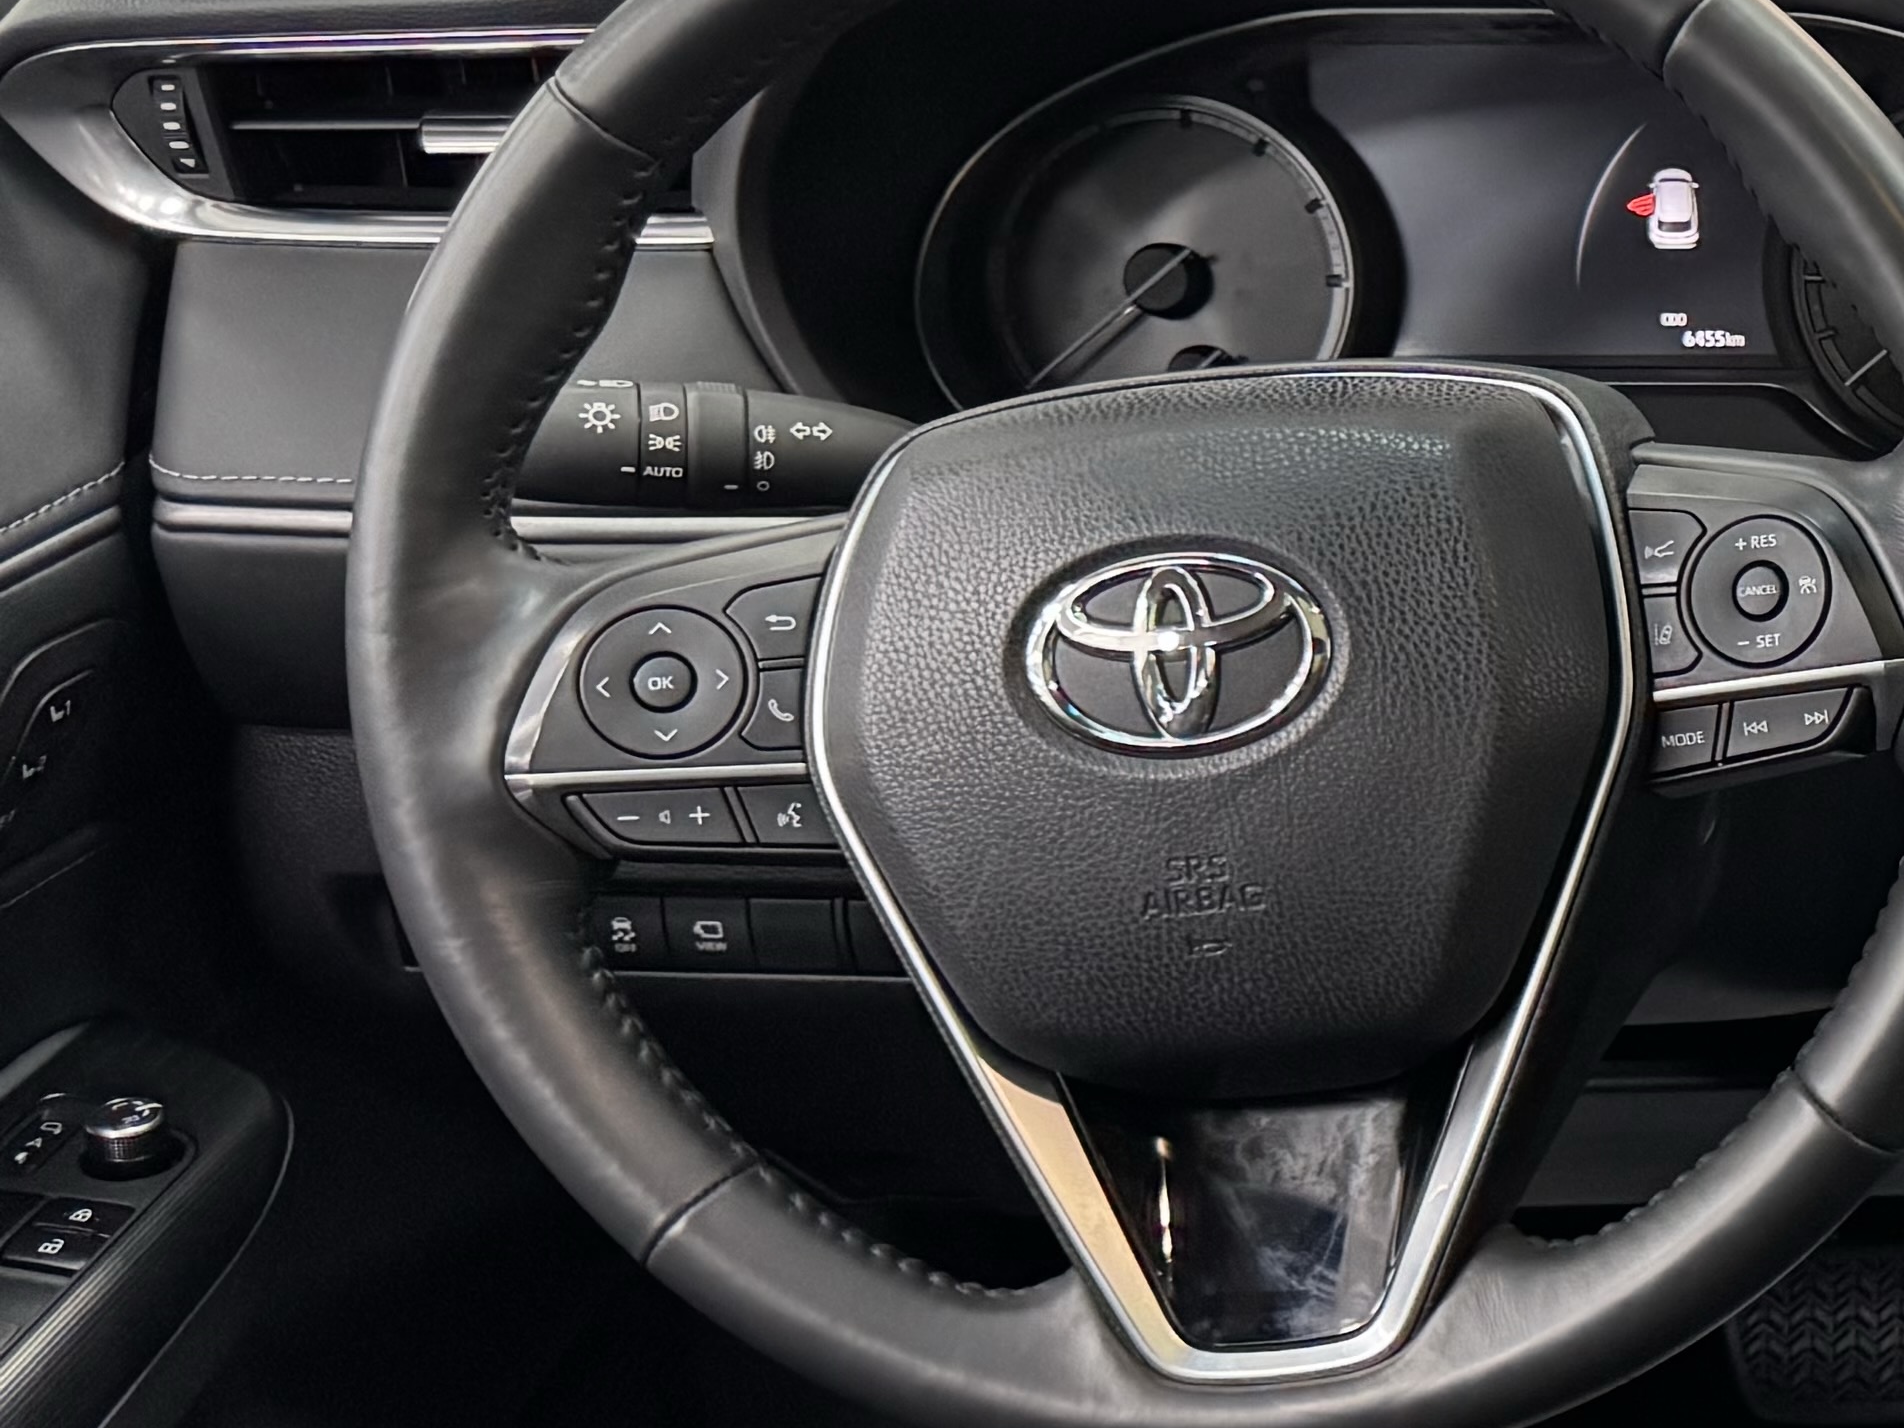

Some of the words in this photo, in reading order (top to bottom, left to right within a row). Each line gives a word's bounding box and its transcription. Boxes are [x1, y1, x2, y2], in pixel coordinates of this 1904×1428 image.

[642, 465, 684, 478] AUTO
[1750, 533, 1777, 549] RES
[1738, 581, 1778, 598] CANCEL
[1756, 632, 1781, 649] SET
[647, 675, 674, 691] OK
[1660, 730, 1706, 748] MODE
[1165, 854, 1230, 884] SRS
[1141, 882, 1267, 919] AIRBAG
